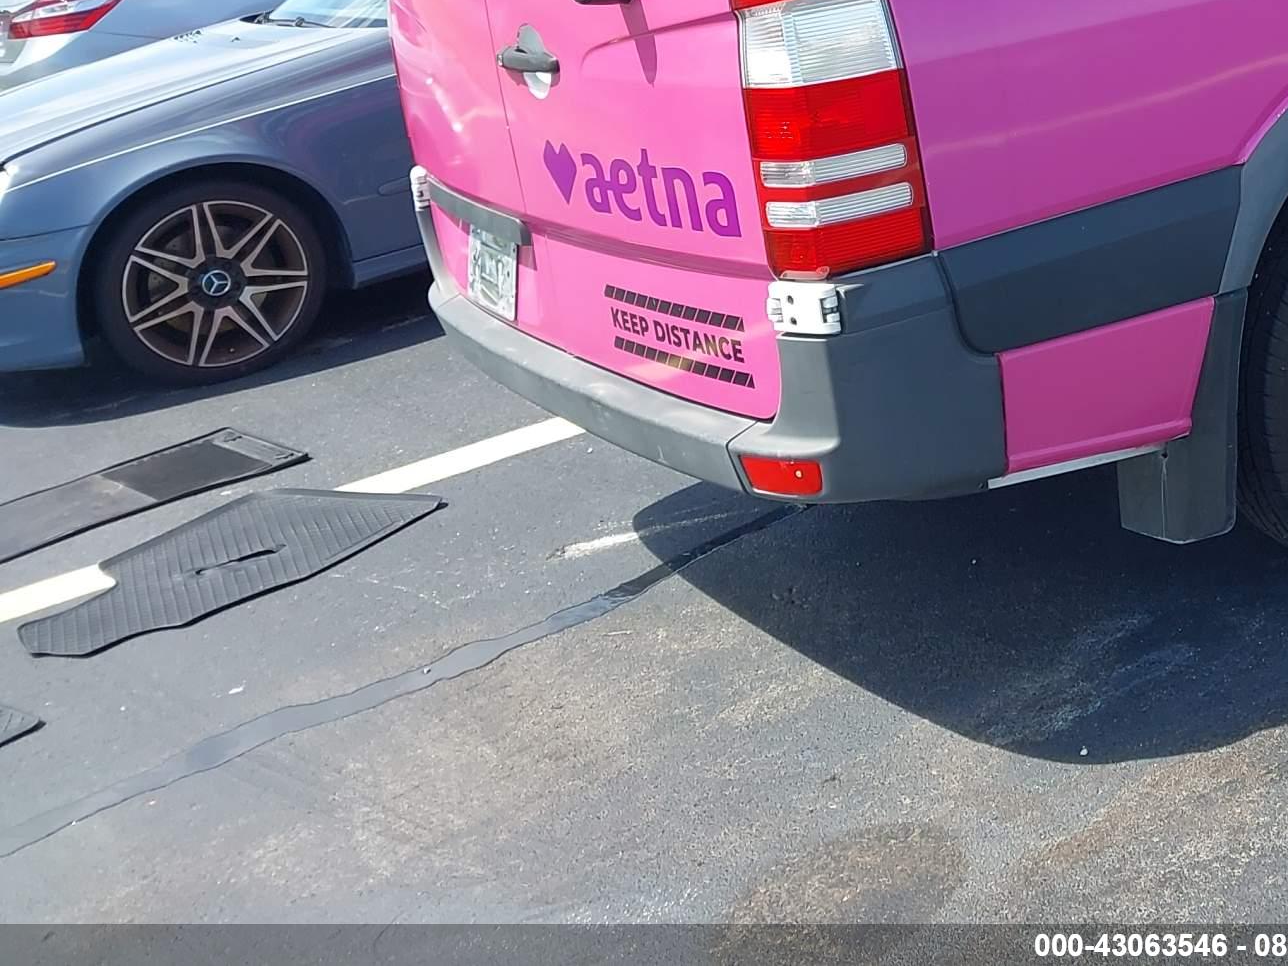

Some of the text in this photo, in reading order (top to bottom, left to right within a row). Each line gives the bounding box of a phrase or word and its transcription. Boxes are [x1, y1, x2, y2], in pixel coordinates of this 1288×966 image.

[580, 148, 742, 237] aetna
[610, 306, 745, 364] KEEP DISTANCE
